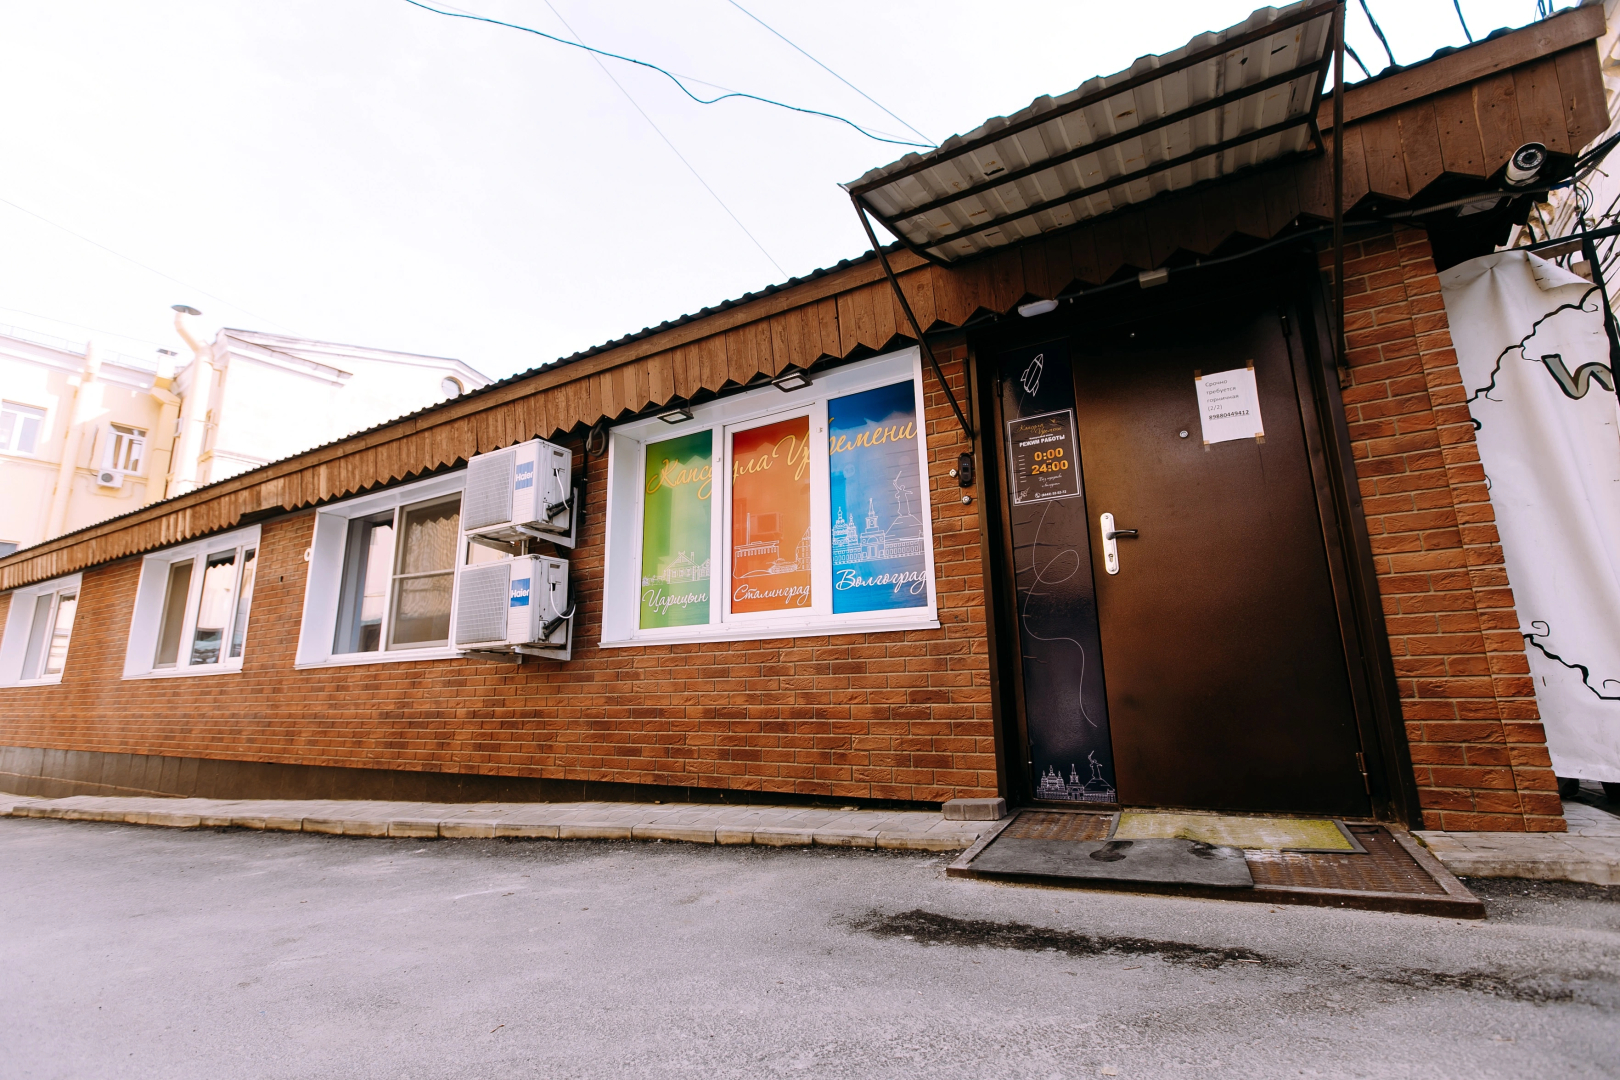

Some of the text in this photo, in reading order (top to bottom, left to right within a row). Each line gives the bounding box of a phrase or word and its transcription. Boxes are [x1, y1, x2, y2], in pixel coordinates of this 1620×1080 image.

[1204, 379, 1228, 387] Срочно
[1206, 386, 1236, 395] требуется
[1019, 438, 1040, 447] РЕЖИМ
[1040, 434, 1066, 443] РАБОТЫ
[1034, 447, 1064, 461] 0:00
[1031, 460, 1068, 475] 24:00
[515, 470, 534, 482] Haier
[835, 568, 927, 595] Волгоград
[510, 587, 530, 599] Haier
[733, 583, 811, 606] Сталинград
[641, 588, 709, 614] Царицын
